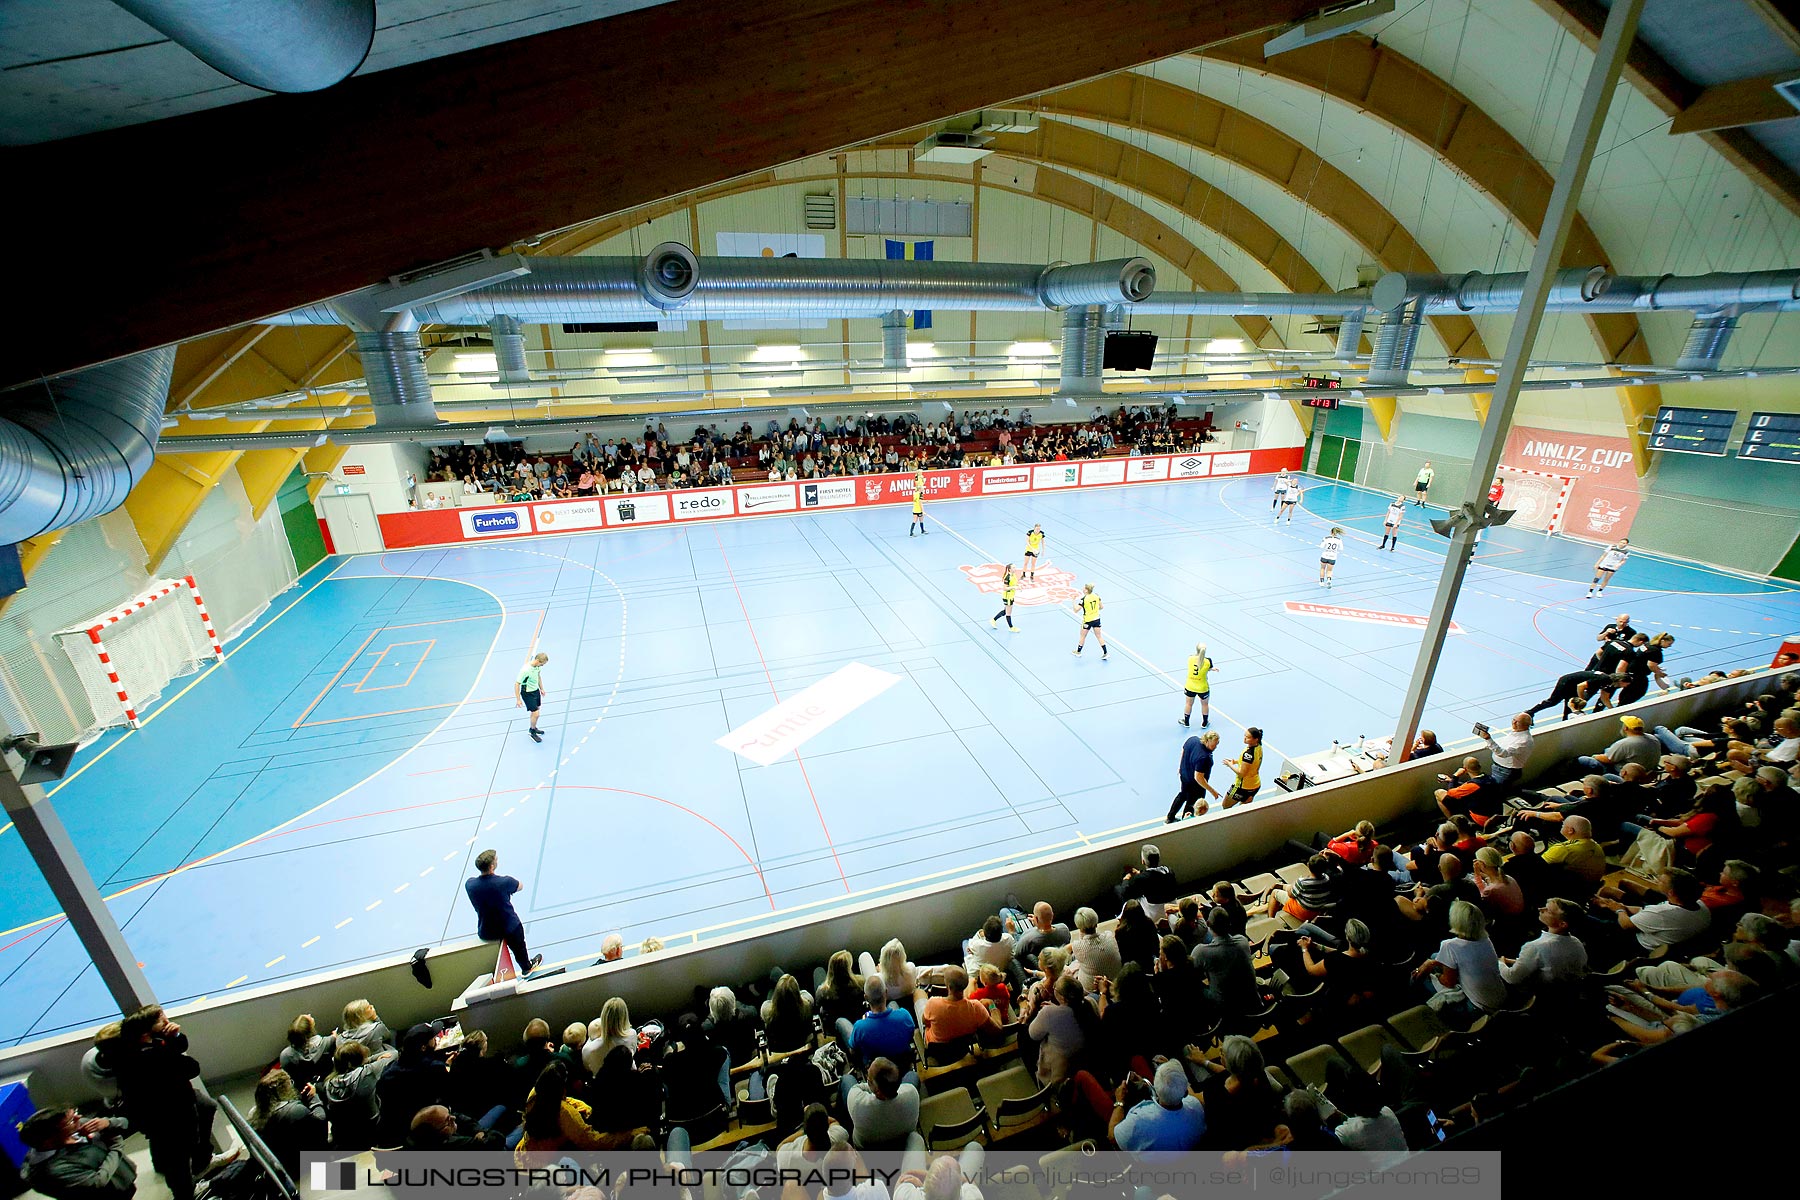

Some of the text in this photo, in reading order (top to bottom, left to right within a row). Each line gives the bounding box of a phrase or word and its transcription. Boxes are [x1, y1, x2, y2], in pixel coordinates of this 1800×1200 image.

[1662, 410, 1674, 421] A
[1757, 416, 1771, 427] D
[1659, 423, 1671, 434] B
[1655, 436, 1666, 447] C
[1751, 431, 1766, 442] E
[1522, 441, 1633, 468] ANNLIZ CUP
[1745, 445, 1760, 456] F
[1539, 458, 1601, 474] SEDAN 2013
[890, 478, 927, 493] ANNLZ
[930, 476, 950, 488] CUP
[680, 497, 720, 510] redo
[476, 516, 516, 527] Furhoffs
[1327, 542, 1337, 550] 20
[1090, 600, 1097, 611] 17
[1299, 604, 1410, 624] Lindströms
[1192, 664, 1199, 676] 3
